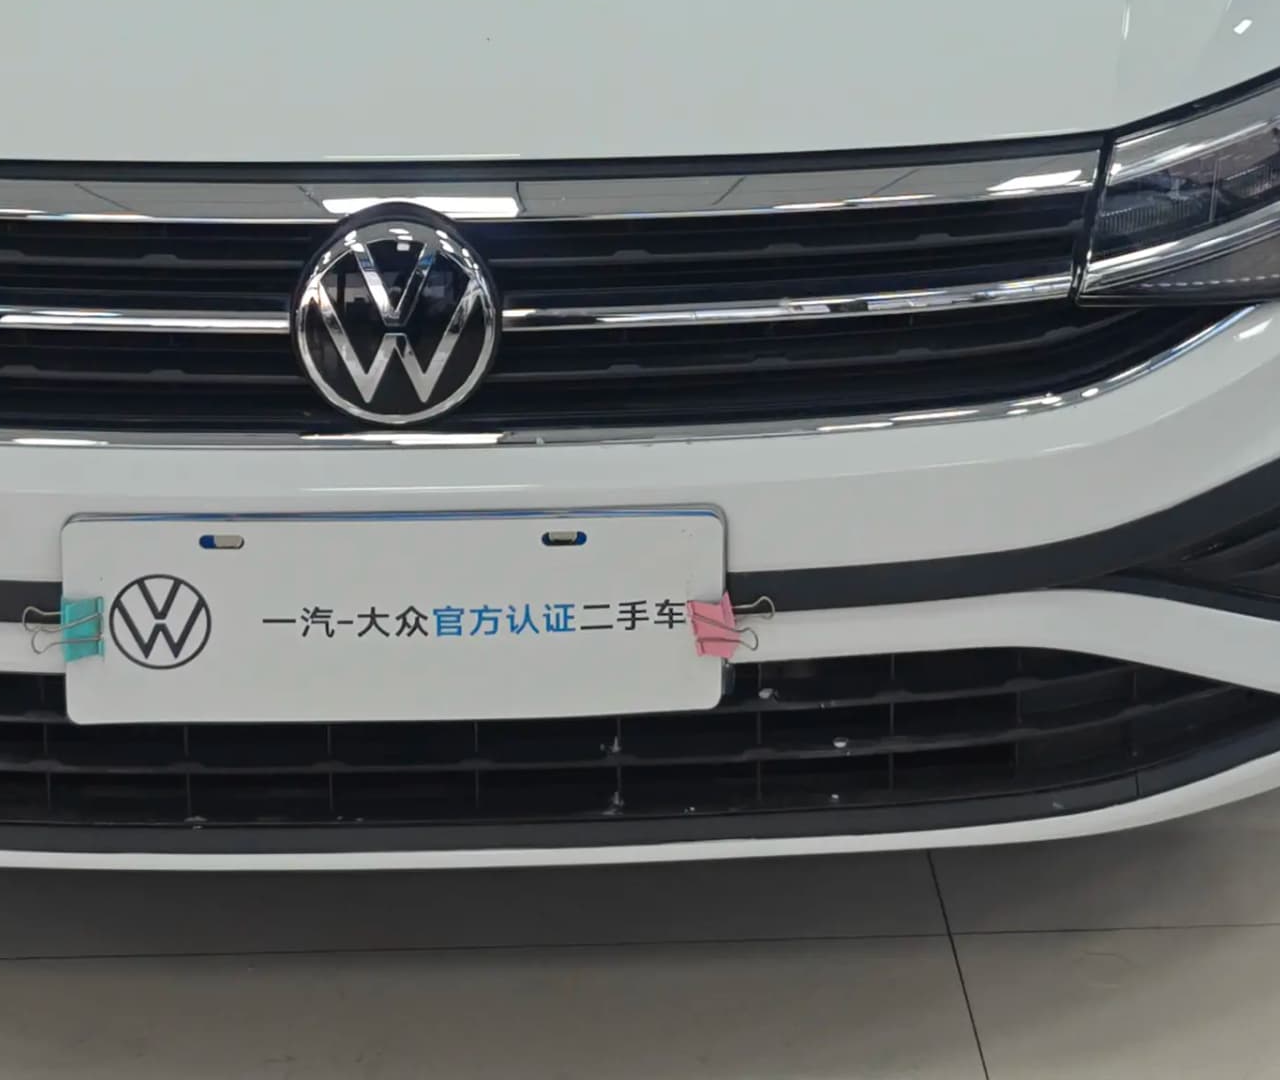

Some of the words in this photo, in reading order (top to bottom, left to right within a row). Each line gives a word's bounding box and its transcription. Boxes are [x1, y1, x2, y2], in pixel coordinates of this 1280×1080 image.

[262, 599, 687, 639] 一汽-大众官方认证二手车
